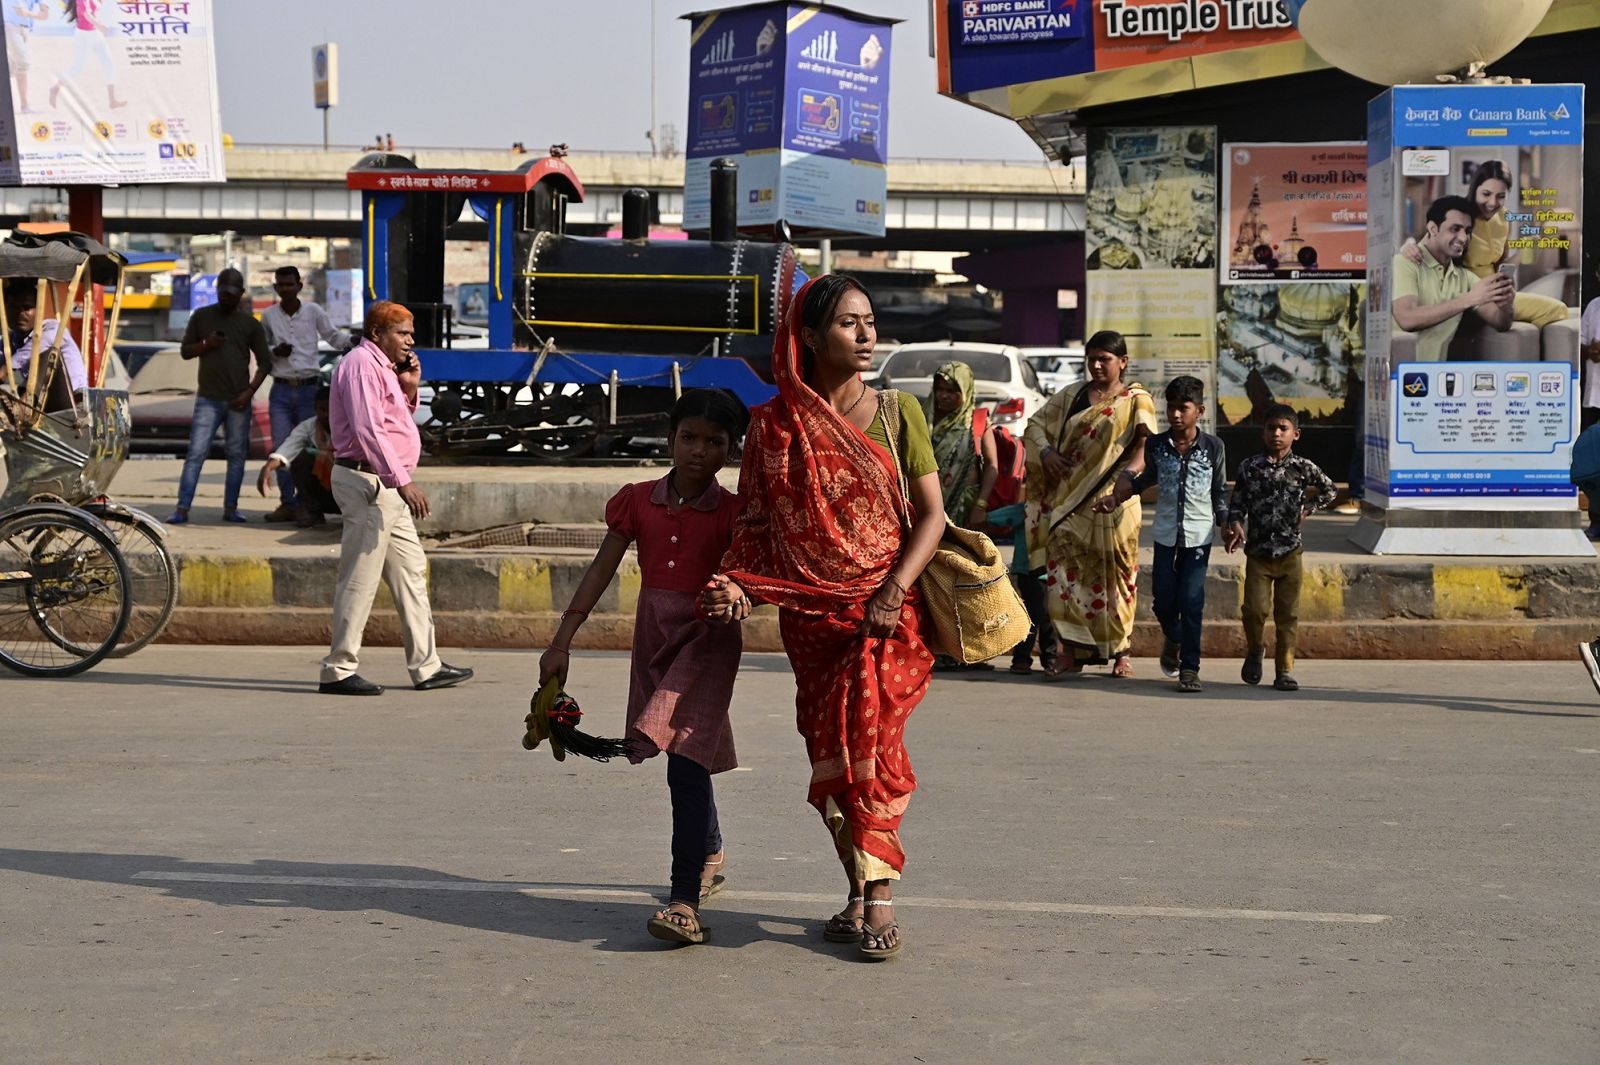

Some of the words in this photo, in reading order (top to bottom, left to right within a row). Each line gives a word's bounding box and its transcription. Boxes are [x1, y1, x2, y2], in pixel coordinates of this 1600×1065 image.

[117, 0, 190, 15] जीवन
[982, 2, 1012, 13] HDFC
[1014, 0, 1046, 11] BANK
[118, 16, 190, 36] शांति
[963, 13, 1071, 33] PARIVARTAN
[1101, 0, 1218, 40] Temple
[1223, 0, 1291, 29] Trus
[964, 34, 971, 42] A
[971, 33, 988, 42] step
[989, 31, 1019, 41] towards
[1020, 30, 1054, 41] progress
[1405, 107, 1439, 122] केनरा
[1442, 105, 1462, 121] बैंक
[1469, 108, 1512, 121] Canara
[1516, 107, 1547, 121] Bank
[175, 144, 195, 157] LIC
[1282, 170, 1298, 184] श्री
[1301, 170, 1338, 184] काशी
[1505, 210, 1533, 222] केनरा
[1536, 210, 1574, 222] डिजिटल
[1520, 224, 1541, 235] सेवा
[1543, 226, 1557, 235] का
[1508, 237, 1534, 249] प्रयोग
[1537, 237, 1570, 250] कीजिए
